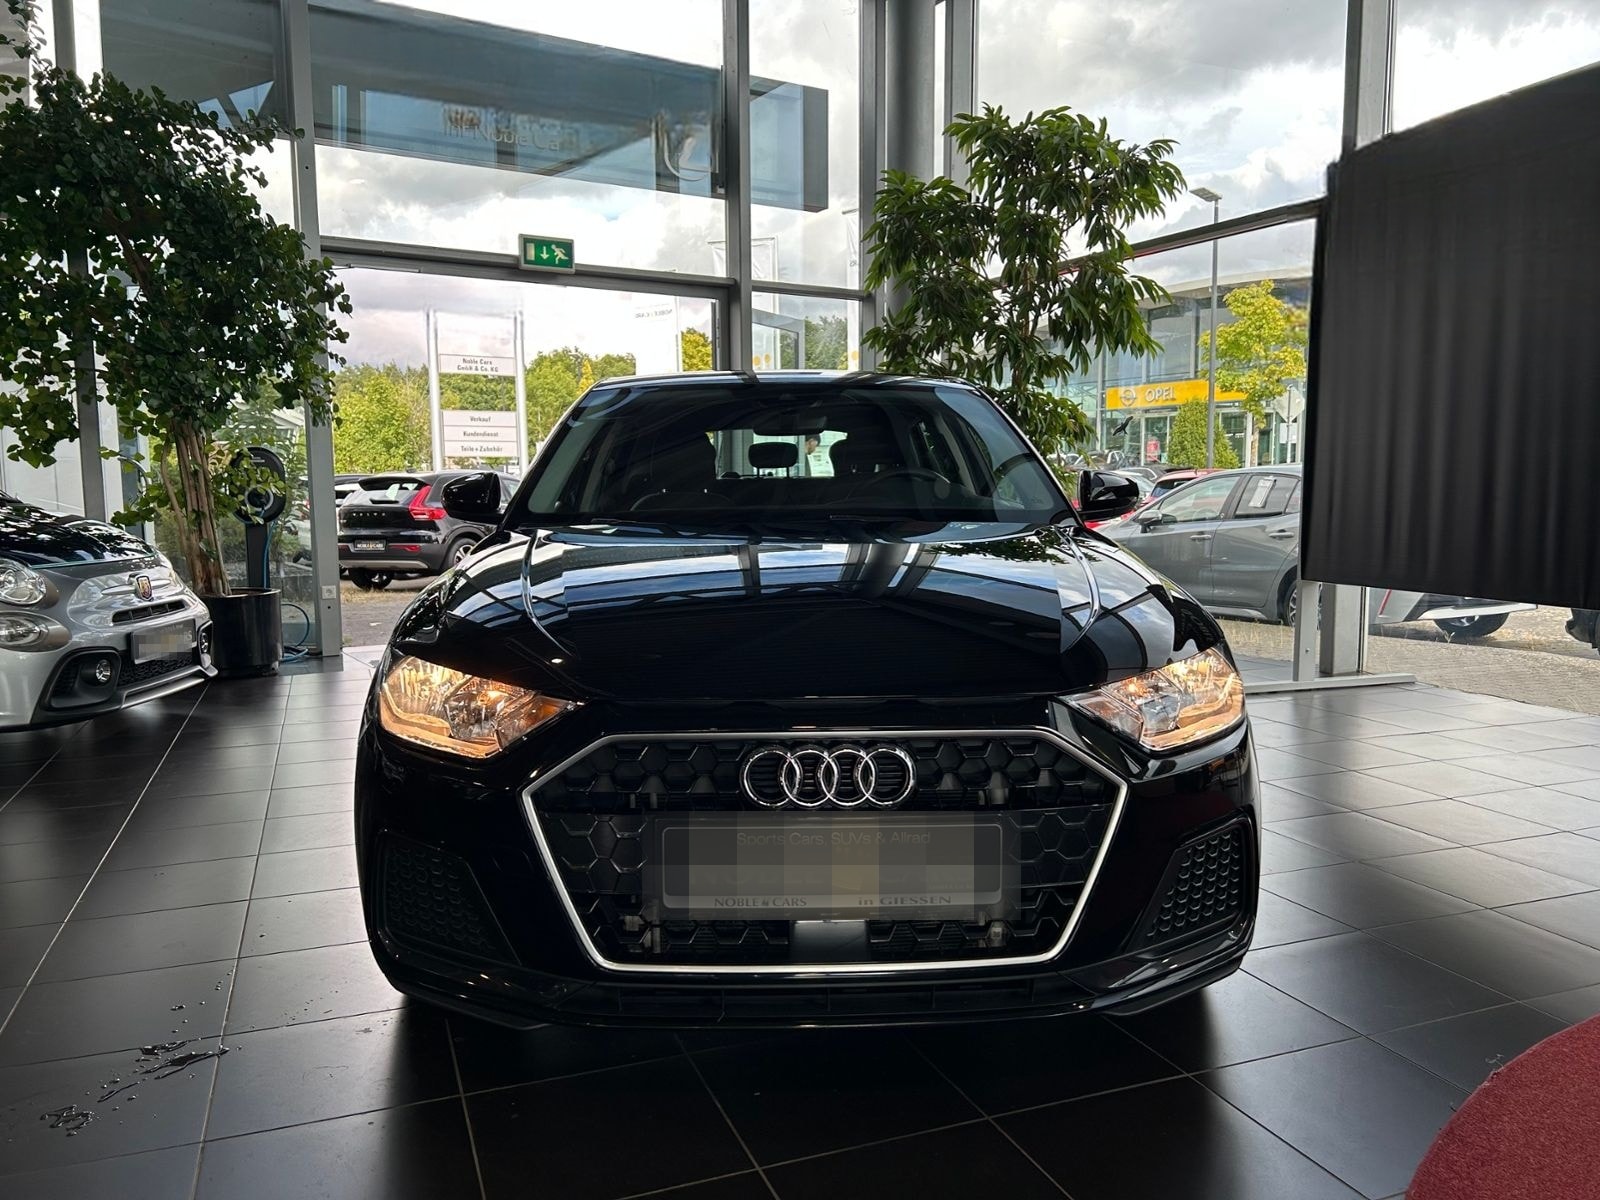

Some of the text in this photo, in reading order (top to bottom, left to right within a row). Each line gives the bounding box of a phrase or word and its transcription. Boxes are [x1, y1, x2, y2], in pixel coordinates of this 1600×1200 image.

[1145, 387, 1176, 402] OPEL
[737, 832, 785, 848] Sports
[831, 831, 871, 846] SUVs
[875, 831, 885, 845] &
[889, 831, 931, 845] Allrad
[714, 895, 952, 907] NOBLE CARS in GIESSEN
